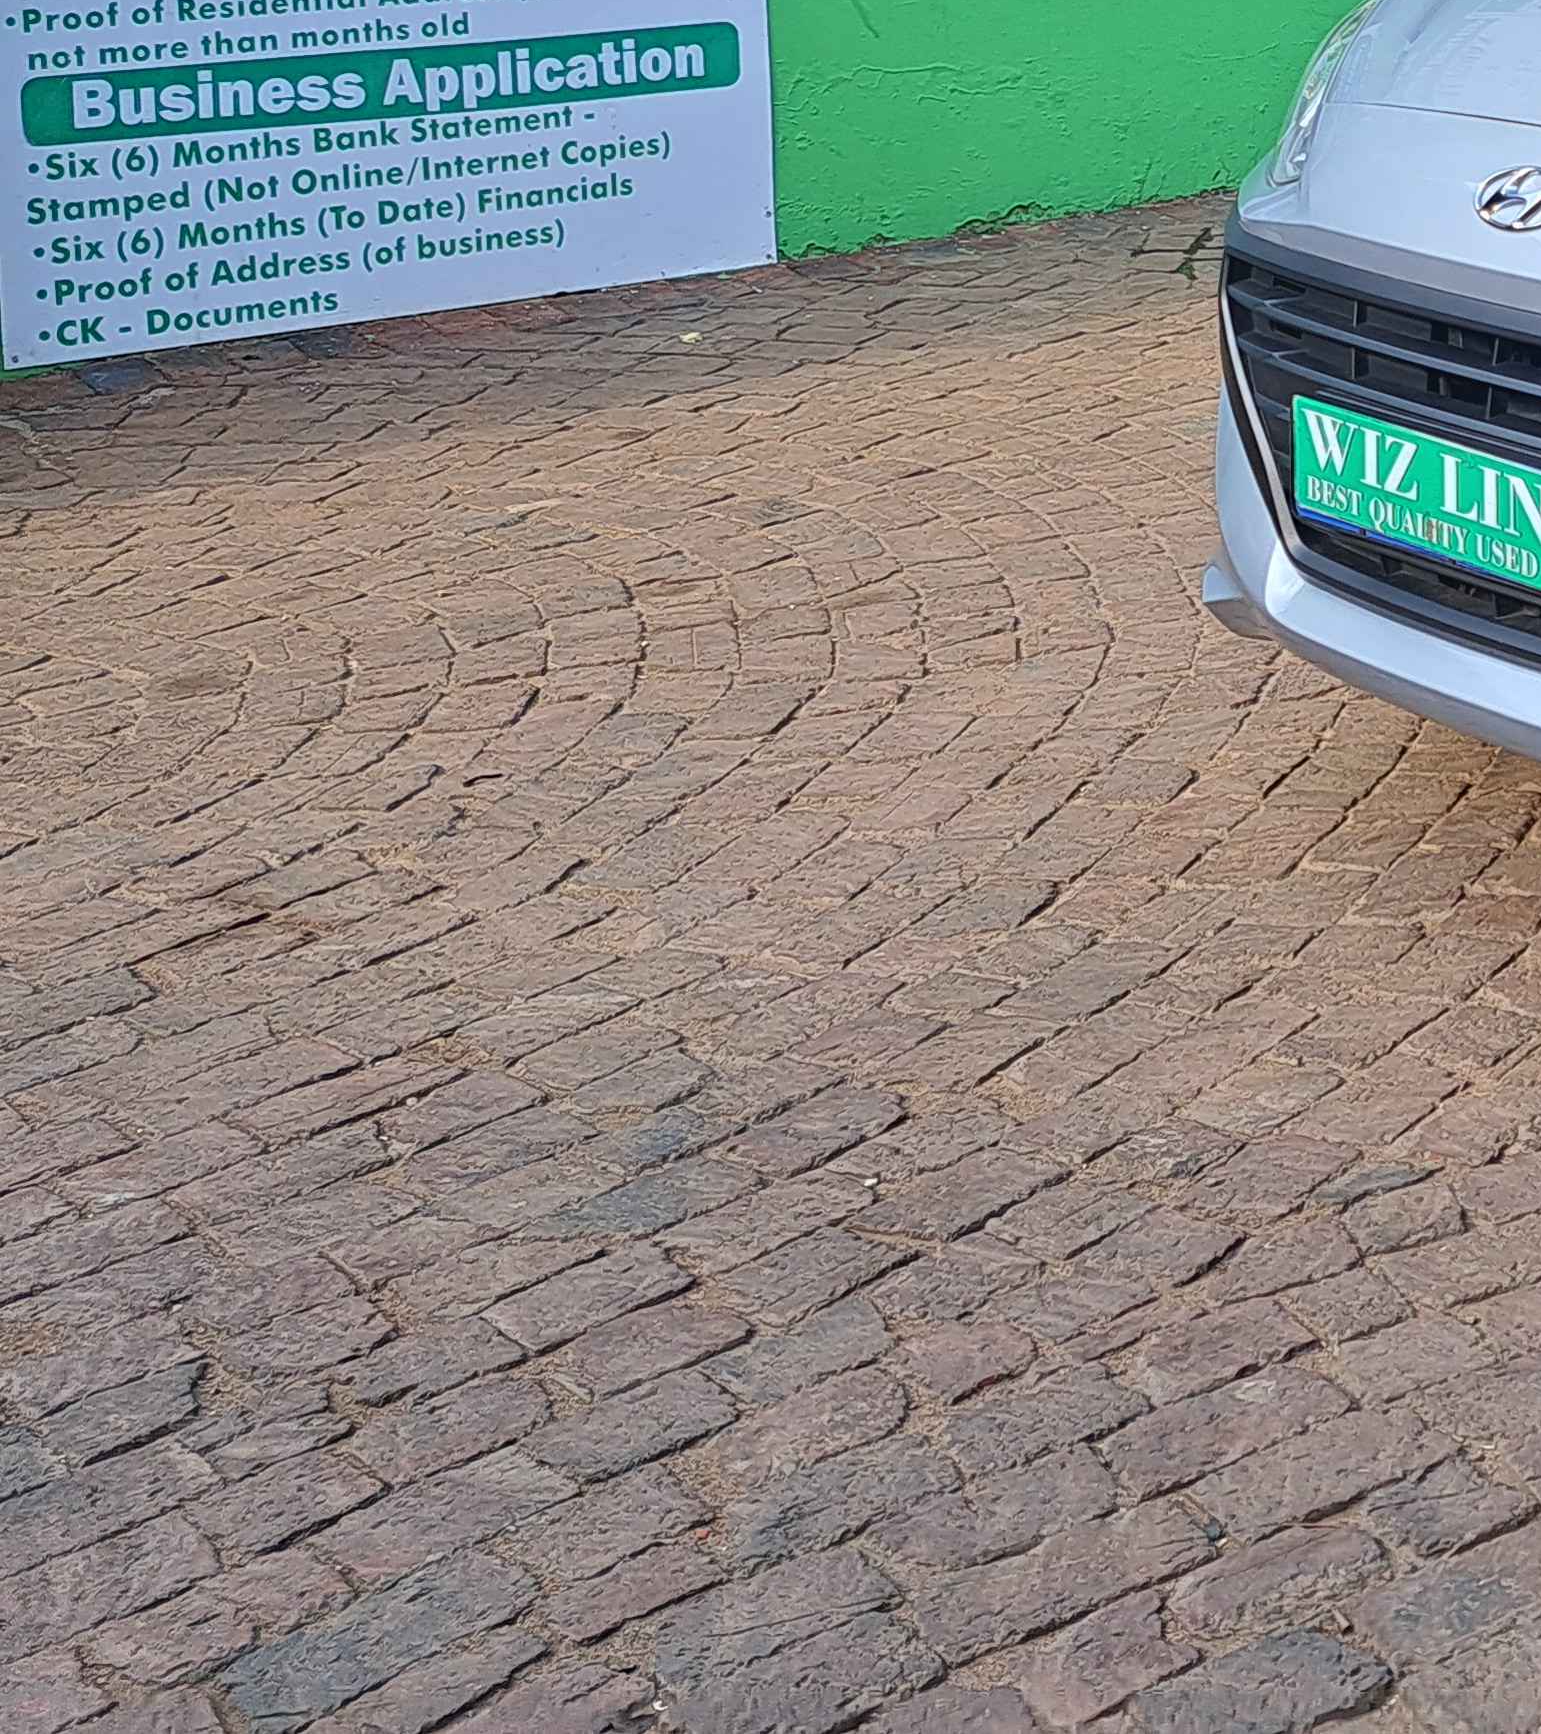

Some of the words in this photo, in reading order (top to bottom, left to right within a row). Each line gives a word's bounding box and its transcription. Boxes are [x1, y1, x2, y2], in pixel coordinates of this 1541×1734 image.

[22, 1, 118, 33] Proof
[131, 0, 164, 25] of
[28, 44, 85, 71] not
[100, 37, 189, 65] more
[202, 31, 278, 56] than
[292, 19, 410, 49] months
[421, 12, 470, 38] old
[72, 70, 366, 130] Business
[383, 38, 705, 112] Application
[27, 181, 190, 225] Stamped
[204, 176, 278, 211] (Not
[292, 147, 550, 196] Online/Internet
[561, 131, 671, 168] Copies)
[46, 153, 98, 180] Six
[112, 145, 159, 180] (6)
[173, 132, 300, 167] Months
[314, 121, 400, 153] Bank
[411, 106, 572, 144] Statement
[56, 315, 106, 346] CK
[147, 291, 338, 336] Documents
[1302, 407, 1419, 502] WIZ
[1307, 474, 1364, 515] BEST
[1368, 497, 1470, 555] QUALITY
[1475, 532, 1539, 580] USED
